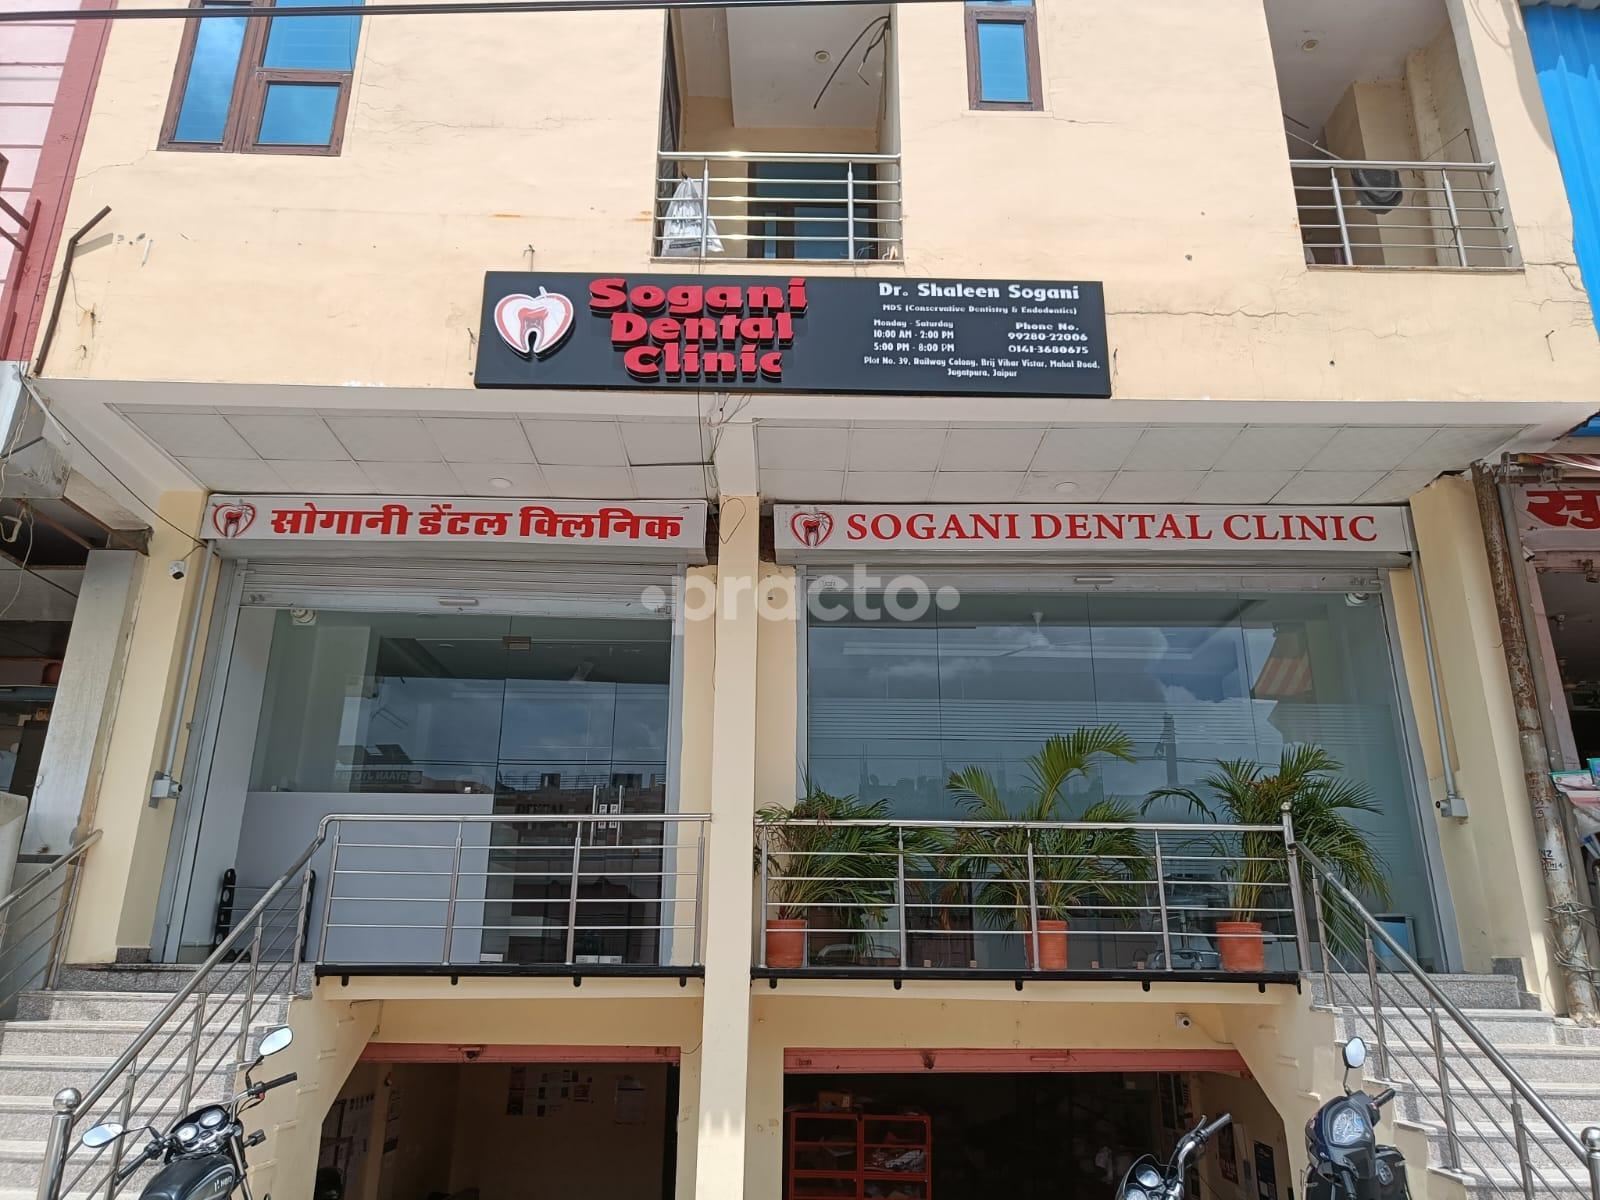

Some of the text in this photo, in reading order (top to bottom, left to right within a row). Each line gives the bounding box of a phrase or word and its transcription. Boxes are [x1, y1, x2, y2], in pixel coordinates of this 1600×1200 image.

[589, 277, 807, 314] Sogani
[878, 282, 1080, 302] Dr. Shaleen Sogani
[905, 304, 966, 313] (Conservative
[968, 305, 1009, 314] Dentistry
[610, 311, 795, 345] Dental
[873, 319, 907, 328] Monday
[915, 320, 954, 328] Saturday
[1015, 322, 1079, 331] Phone No.
[873, 330, 896, 338] 10:00
[899, 330, 912, 338] AM
[920, 331, 939, 339] 2:00
[941, 331, 954, 339] PM
[1007, 332, 1088, 341] 99280-22006
[873, 342, 894, 351] 5:00
[896, 342, 910, 351] PM
[918, 343, 939, 352] 8:00
[941, 343, 955, 352] PM
[1008, 344, 1089, 354] 0141-3680675
[624, 342, 783, 376] Clinic
[863, 356, 880, 364] Plot
[882, 357, 896, 365] No.
[898, 357, 911, 366] 39,
[913, 357, 946, 367] Railway
[948, 358, 979, 367] Colony,
[981, 358, 995, 367] Brij
[997, 358, 1019, 367] Vihar
[1021, 359, 1048, 368] Vistar,
[1049, 360, 1075, 368] Mahal
[993, 369, 1017, 378] Jaipur
[271, 502, 684, 541] सोगानी डेंटल क्लिनिक
[846, 513, 1379, 542] SOGANI DENTAL CLINIC
